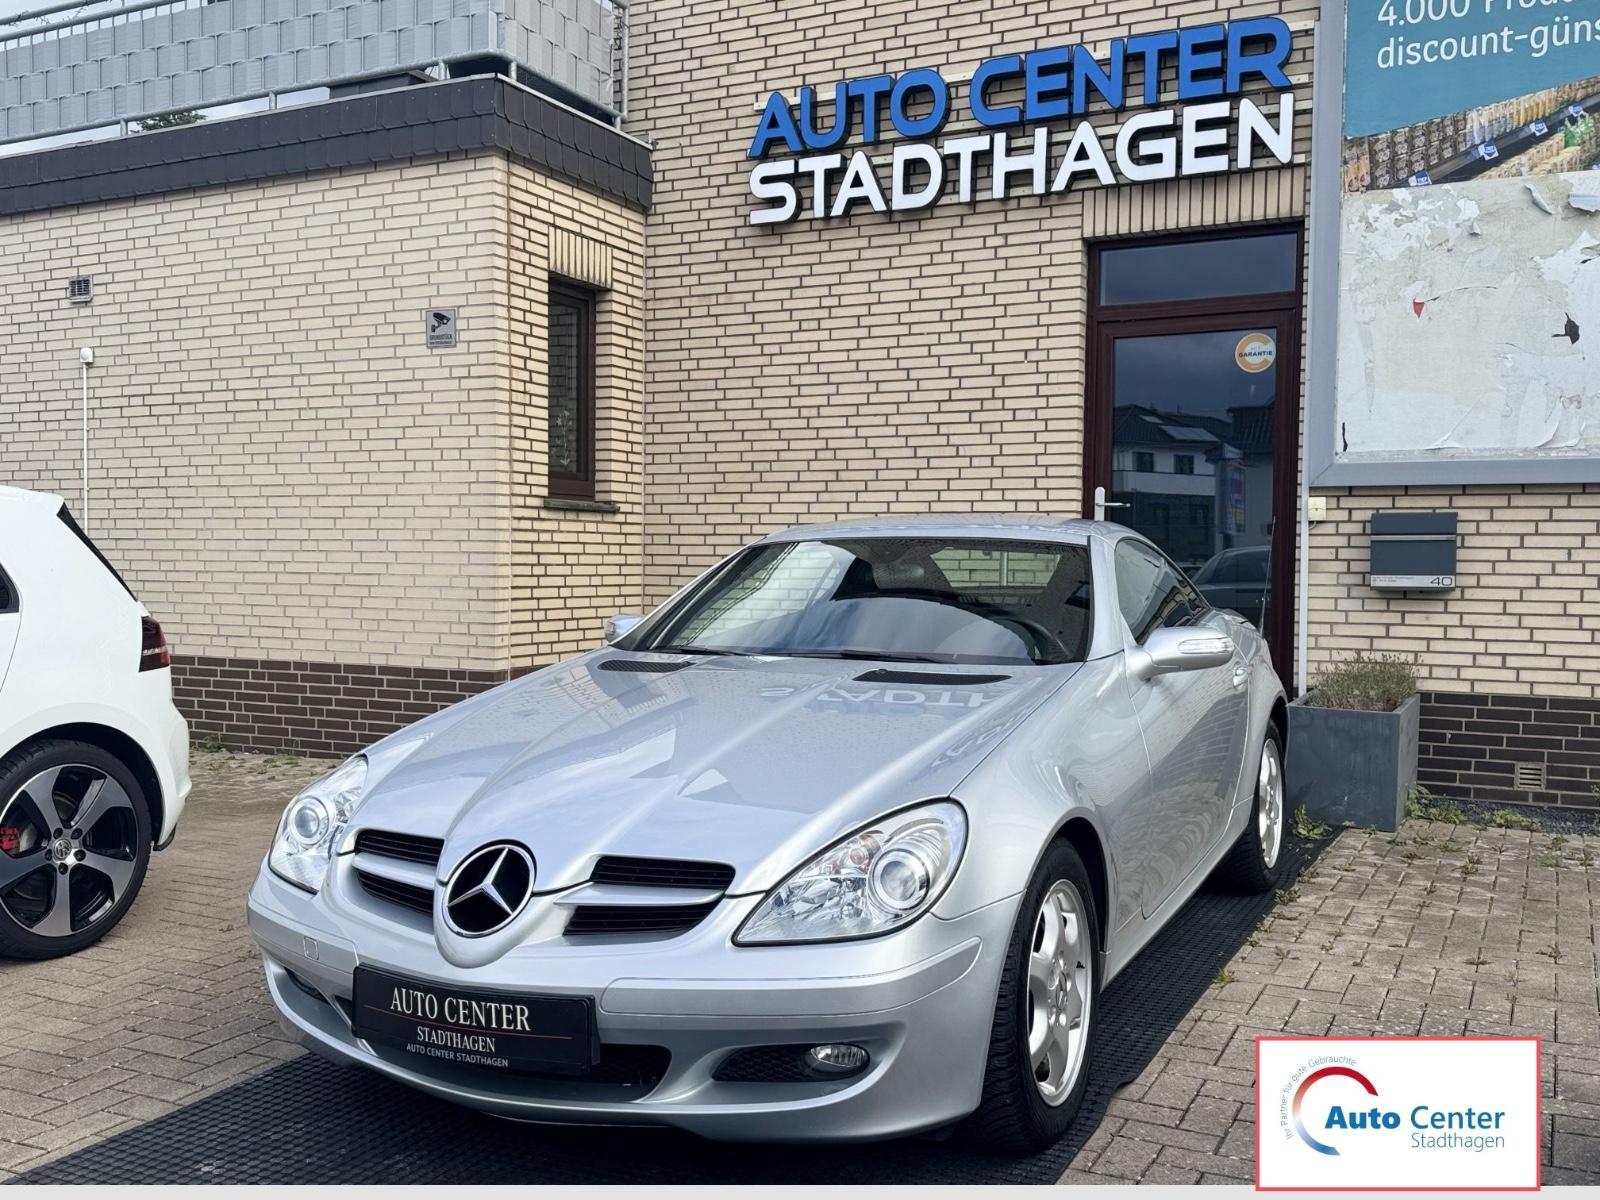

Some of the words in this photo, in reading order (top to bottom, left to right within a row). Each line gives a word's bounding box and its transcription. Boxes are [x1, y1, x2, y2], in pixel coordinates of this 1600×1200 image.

[748, 68, 950, 159] AUTO
[969, 16, 1293, 127] CENTER
[748, 92, 1295, 226] STADTHAGEN
[1430, 576, 1453, 586] 40
[390, 986, 438, 1019] AUTO
[444, 997, 531, 1032] CENTER
[406, 1042, 426, 1055] AUTO
[426, 1046, 455, 1061] CENTER
[456, 1052, 509, 1068] STADTHAGEN
[417, 1025, 496, 1053] STADTHAGEN
